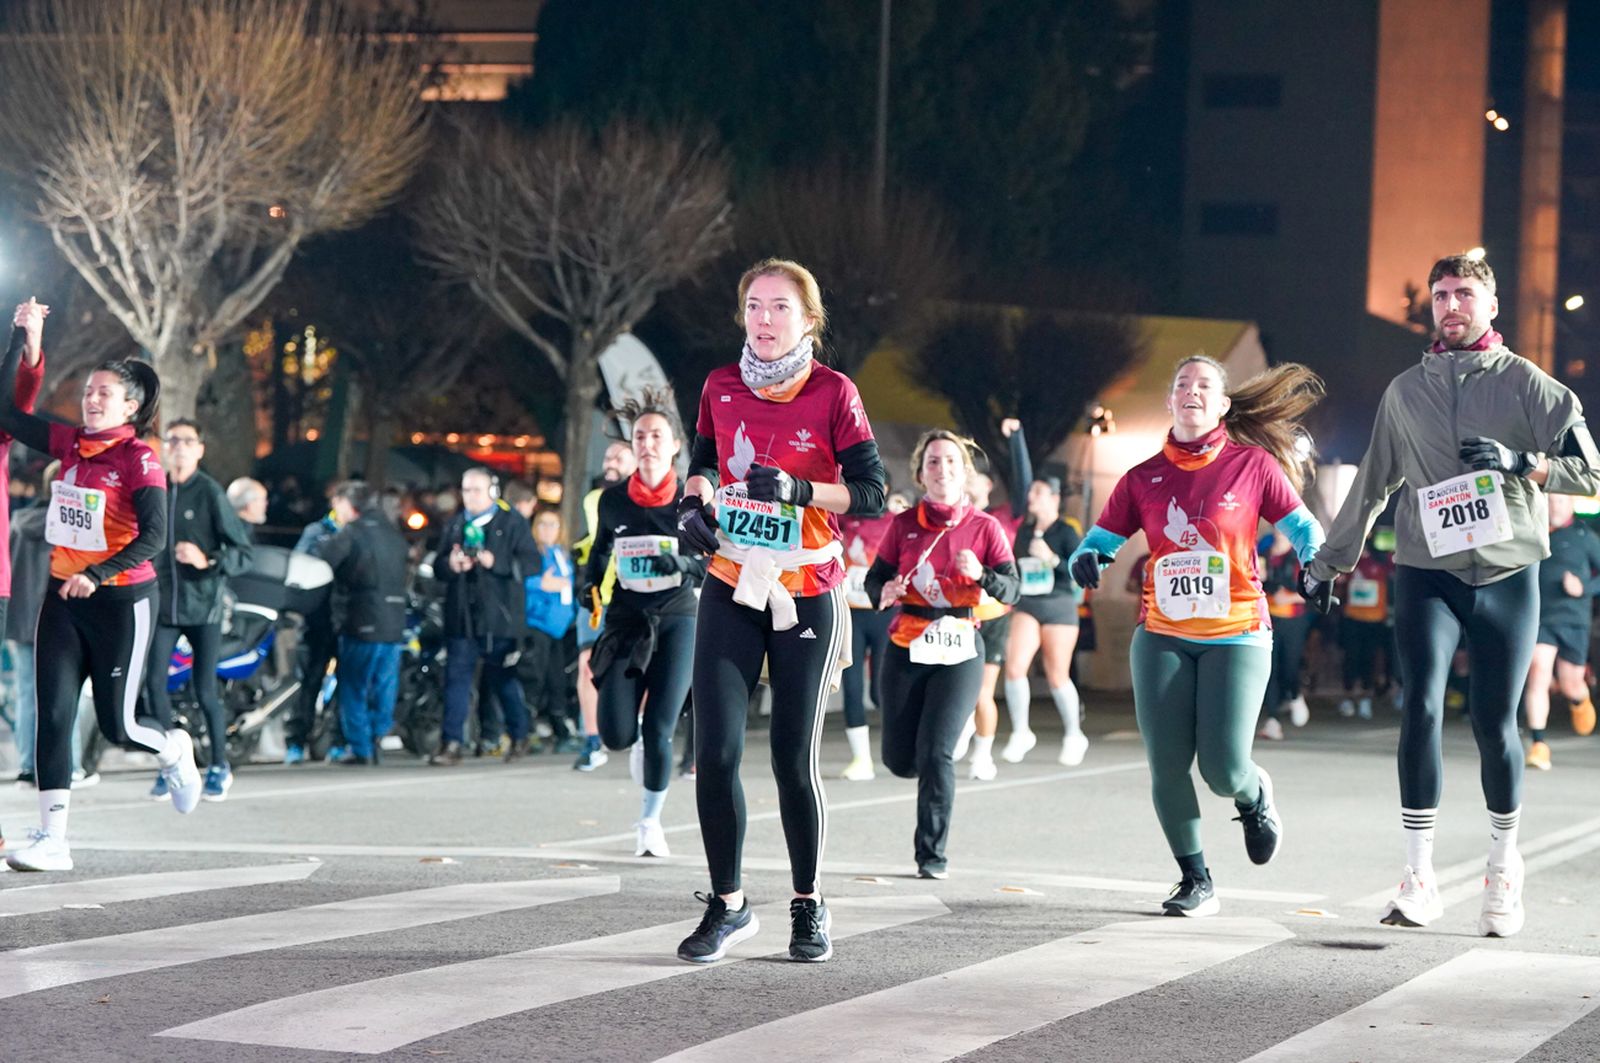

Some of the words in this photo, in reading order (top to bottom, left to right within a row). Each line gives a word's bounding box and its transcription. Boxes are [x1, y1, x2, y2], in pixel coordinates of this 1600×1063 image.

[1437, 485, 1458, 498] NOCHE
[1459, 482, 1469, 492] DE
[725, 497, 743, 508] SAN
[1428, 499, 1445, 510] SAN
[60, 505, 92, 530] 6959
[1438, 498, 1490, 529] 2018
[727, 509, 792, 543] 12451
[1180, 530, 1198, 546] 43
[630, 556, 653, 573] 87
[1171, 558, 1191, 567] NOCHE
[1192, 557, 1201, 566] DE
[1162, 567, 1177, 576] SAN
[923, 584, 941, 601] 43
[1169, 575, 1214, 597] 2019
[924, 631, 962, 648] 6184
